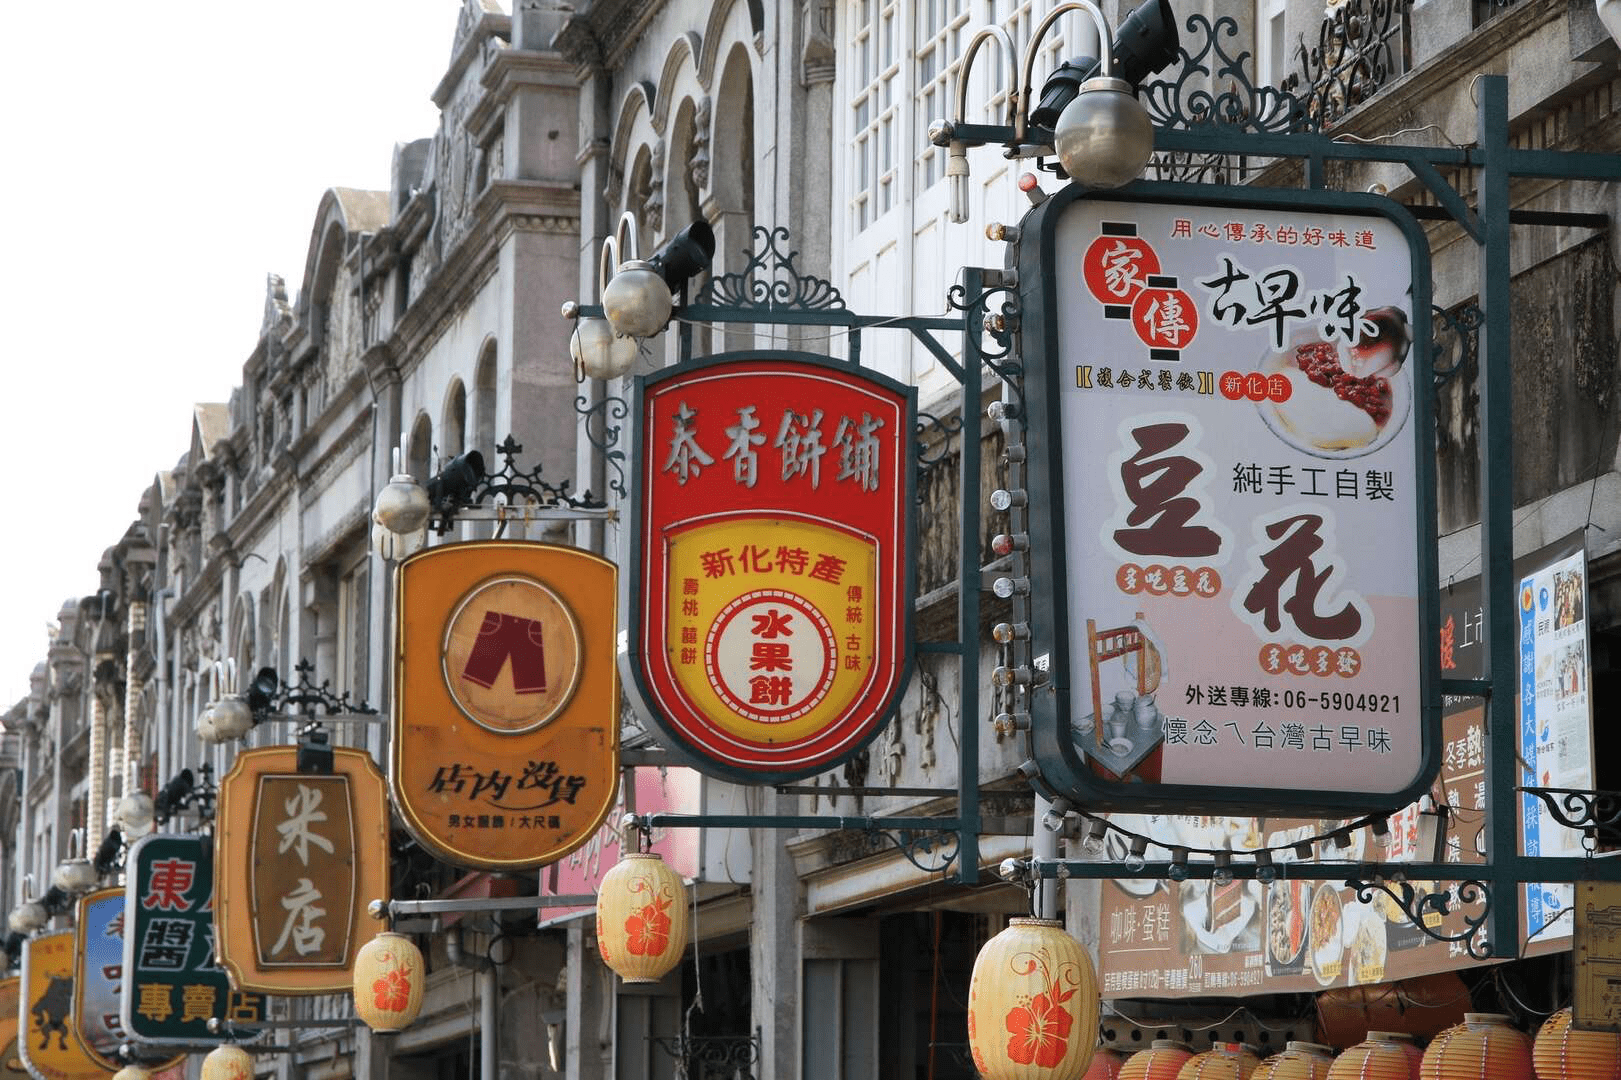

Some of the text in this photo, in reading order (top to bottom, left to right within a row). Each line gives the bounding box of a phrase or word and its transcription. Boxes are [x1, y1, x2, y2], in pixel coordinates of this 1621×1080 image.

[1170, 219, 1377, 249] 用心傳承的好味道
[1201, 258, 1379, 348] 古早味
[1224, 375, 1284, 397] 新化店
[1232, 462, 1395, 501] 純手工自製
[700, 545, 848, 585] 新化特產
[1124, 566, 1215, 594] 多吃豆花
[748, 609, 794, 706] 水果餅
[1186, 685, 1401, 714] 外送專線:06-5904921
[1446, 725, 1485, 771] 冬季熱
[426, 760, 587, 805] 店內沒貨
[272, 784, 335, 956] 米店
[137, 983, 260, 1023] 專賣店
